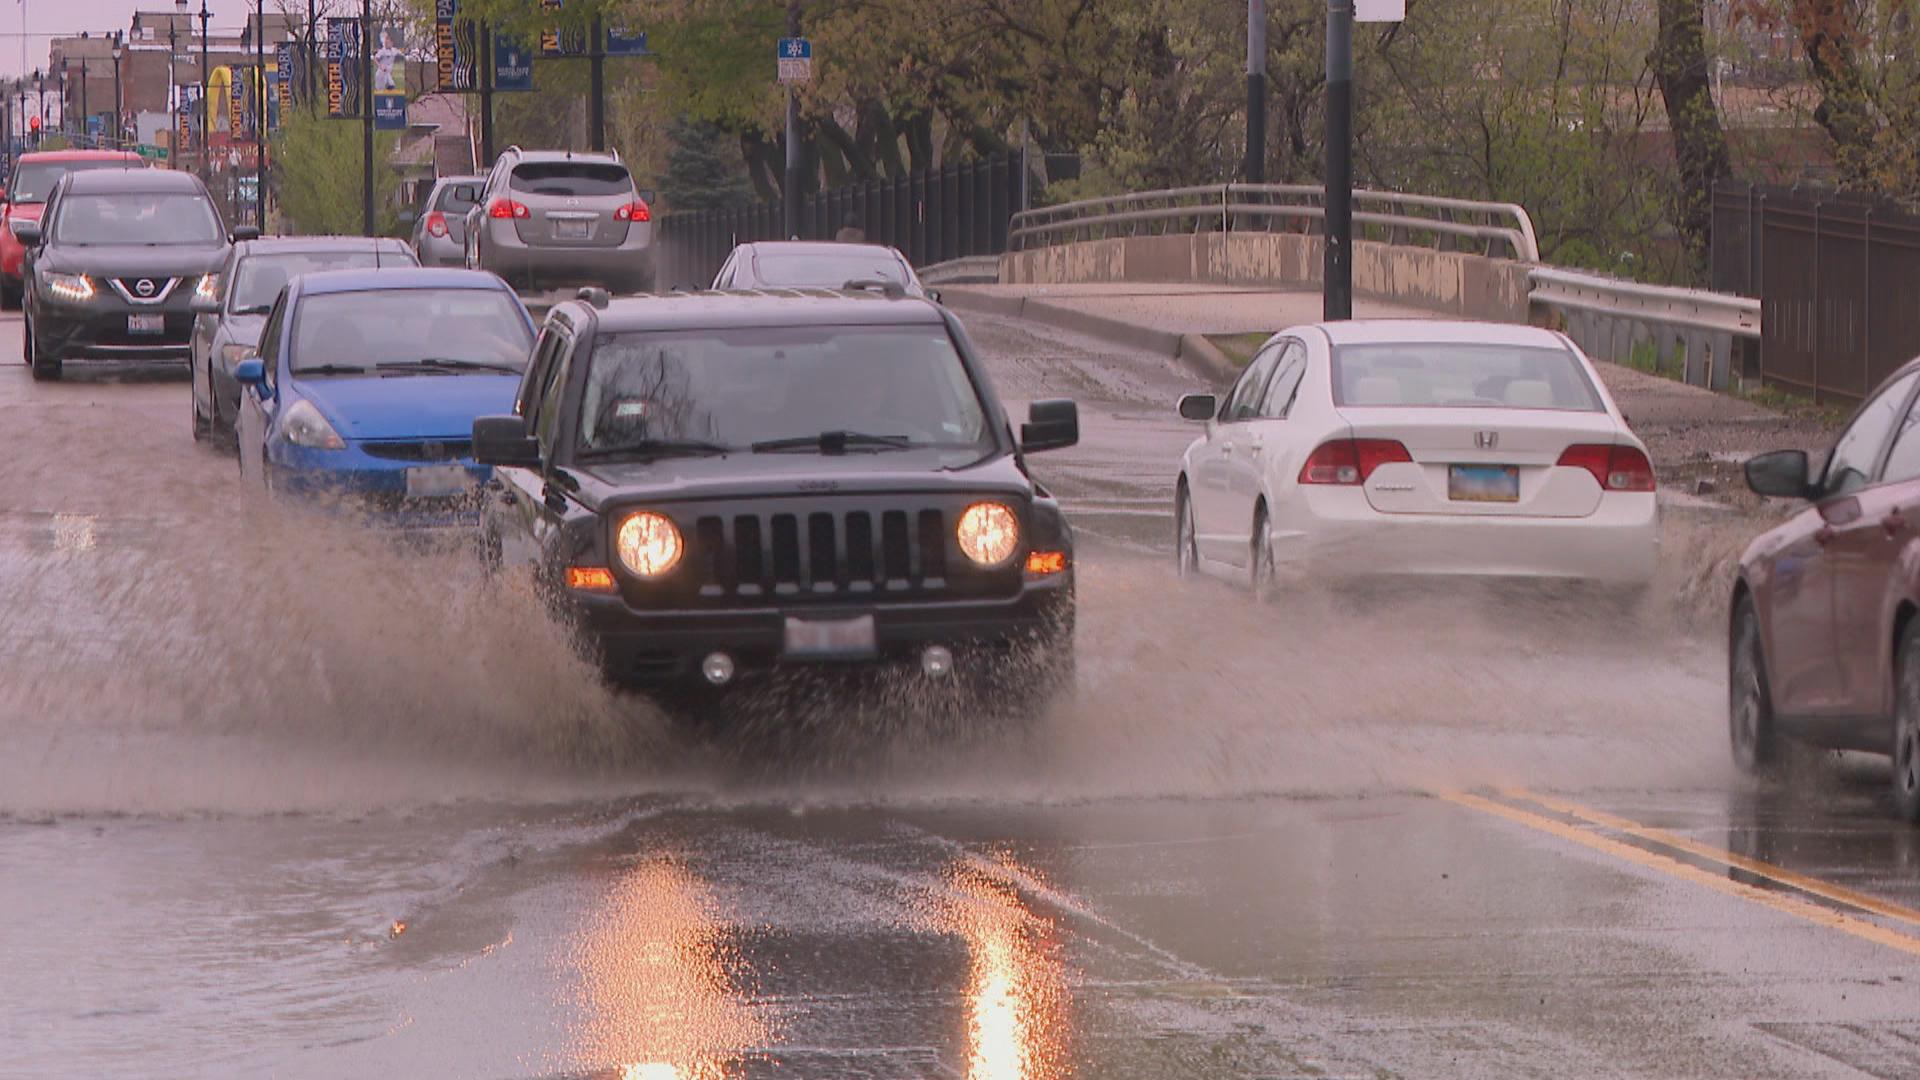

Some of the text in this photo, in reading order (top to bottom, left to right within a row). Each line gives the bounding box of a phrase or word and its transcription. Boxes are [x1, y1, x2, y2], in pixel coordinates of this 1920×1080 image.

[279, 47, 290, 127] NORTH PARK
[329, 23, 341, 113] NORTH PARK
[438, 24, 454, 86] NORTH
[180, 115, 190, 148] NORTH
[231, 68, 241, 138] NORTH PARK
